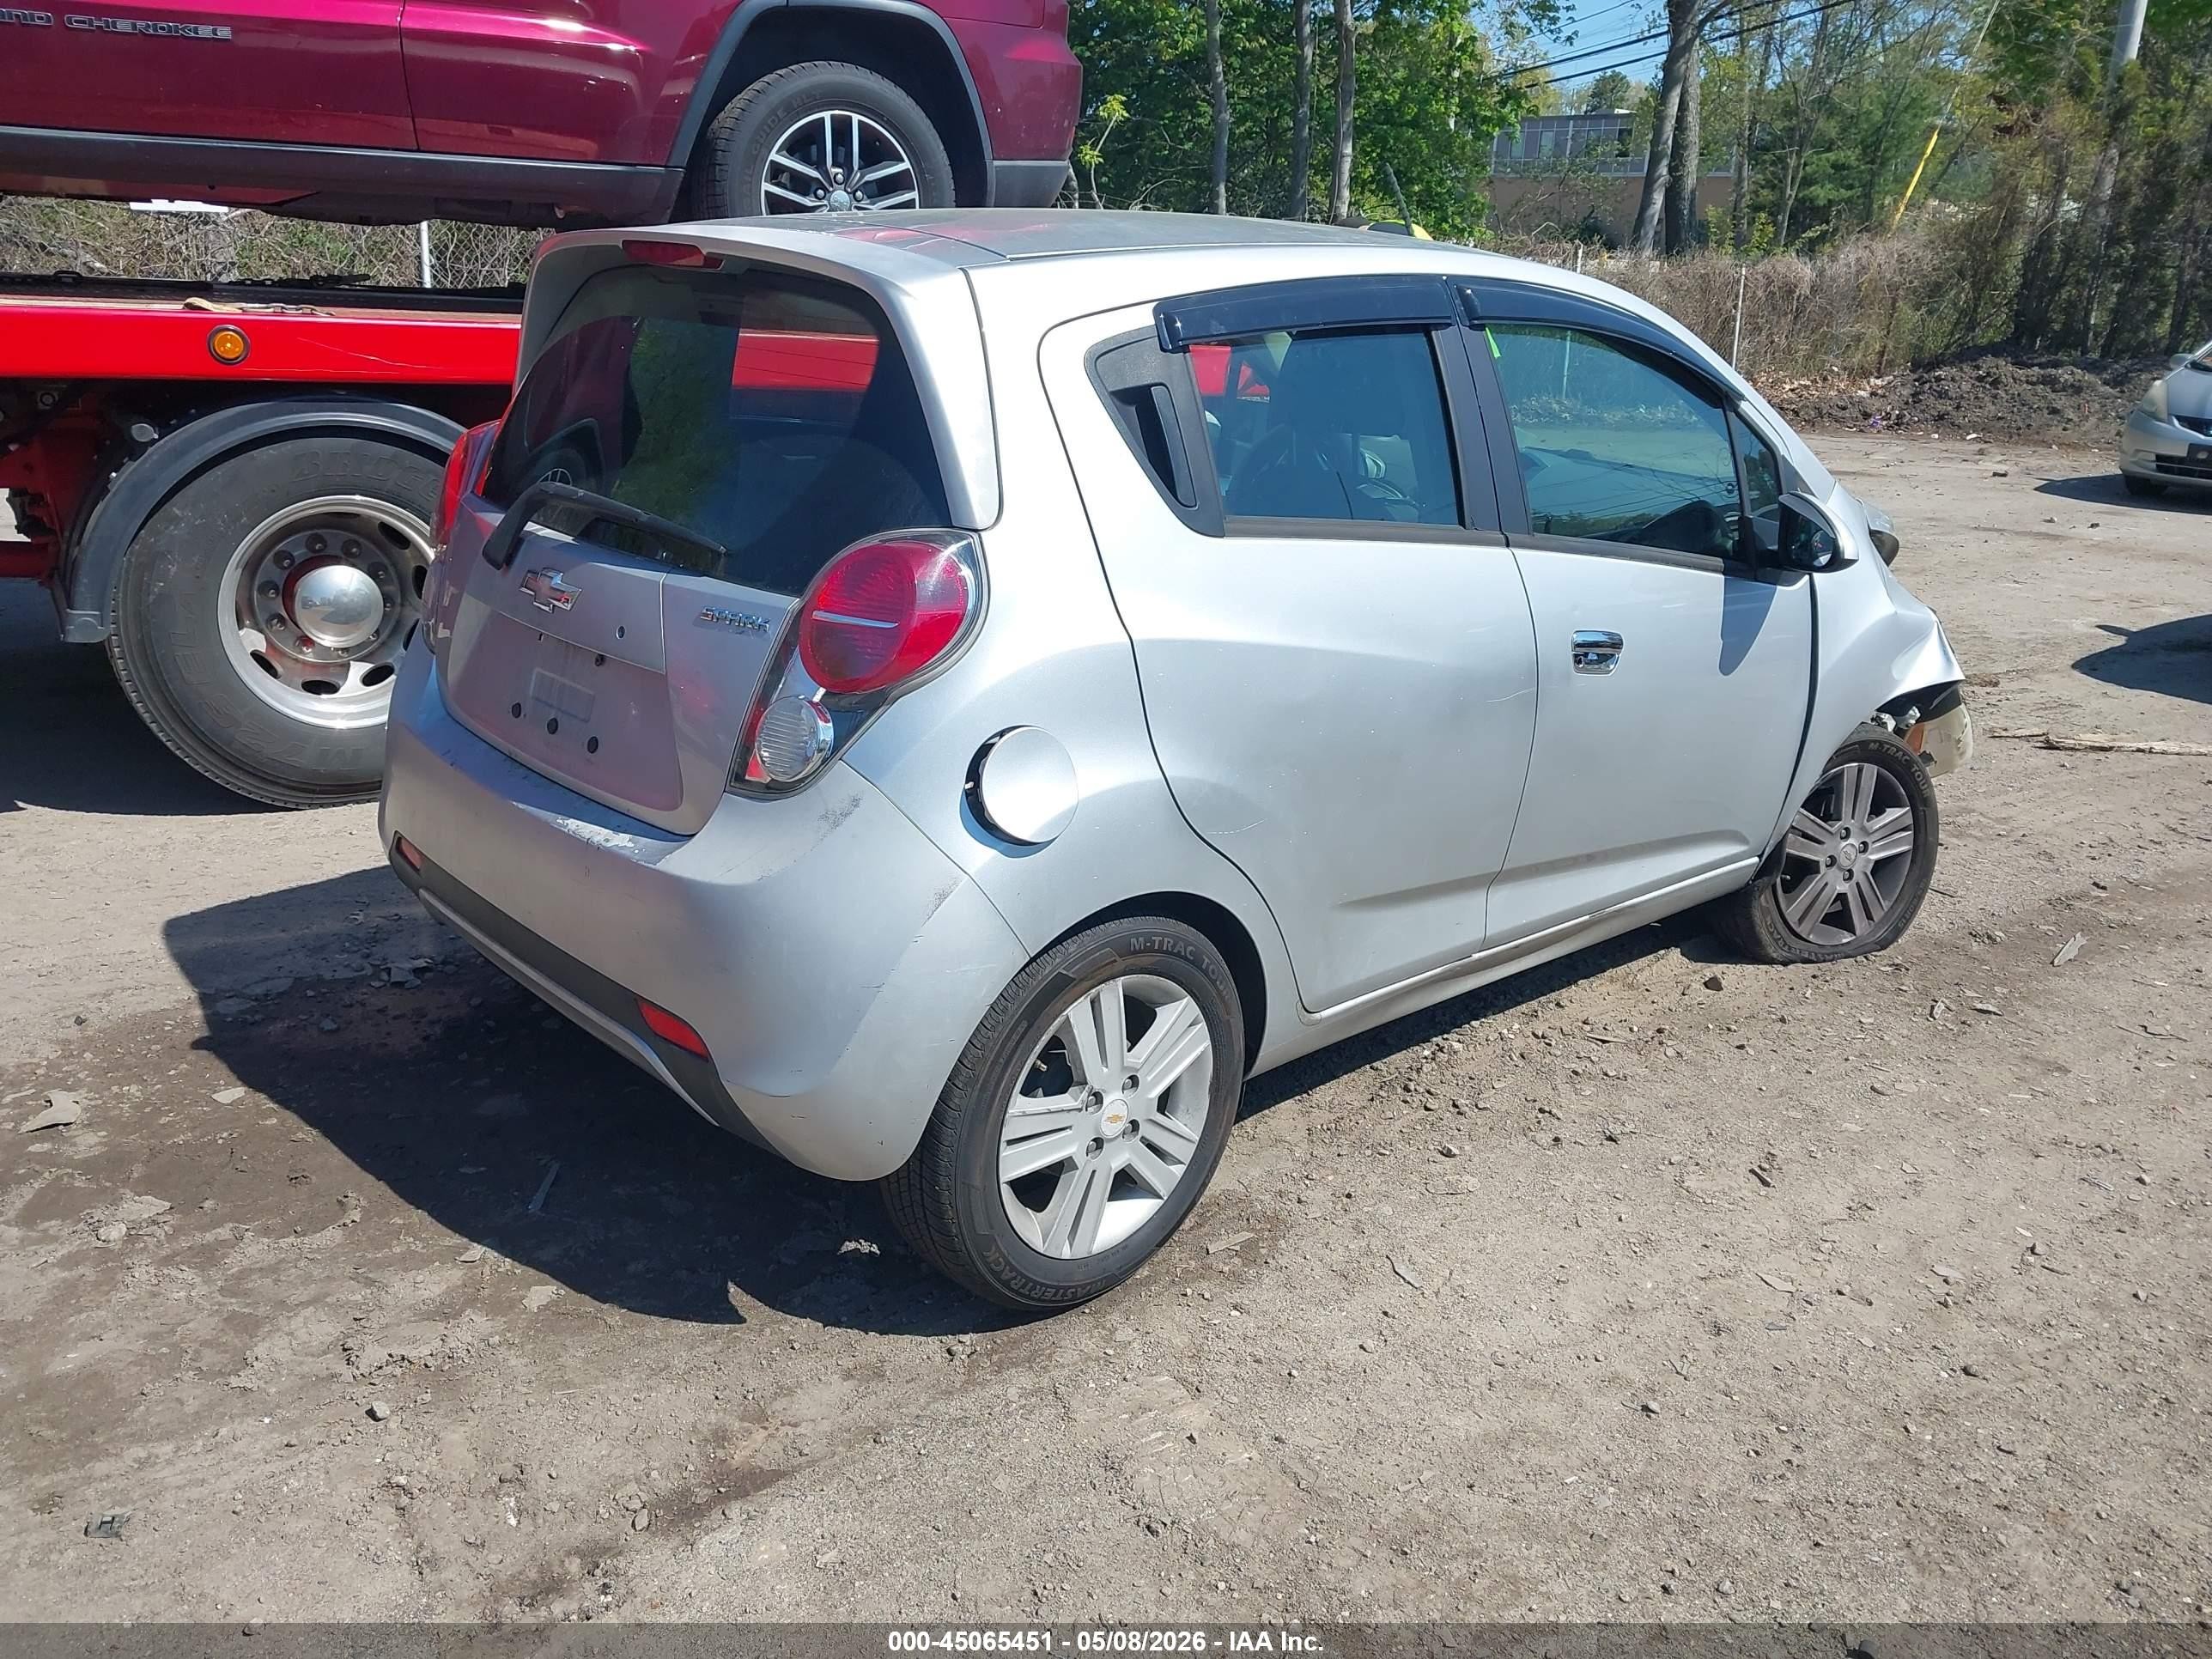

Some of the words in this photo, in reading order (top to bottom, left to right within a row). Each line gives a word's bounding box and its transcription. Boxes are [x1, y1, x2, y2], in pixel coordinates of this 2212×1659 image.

[65, 15, 232, 40] CHEROKEE
[700, 606, 770, 633] SPARK
[1869, 742, 1911, 764] M-TRAC
[1911, 764, 1931, 799] TOUR
[1130, 936, 1196, 960] M-TRAC
[983, 1245, 1106, 1301] MASTERTRACK
